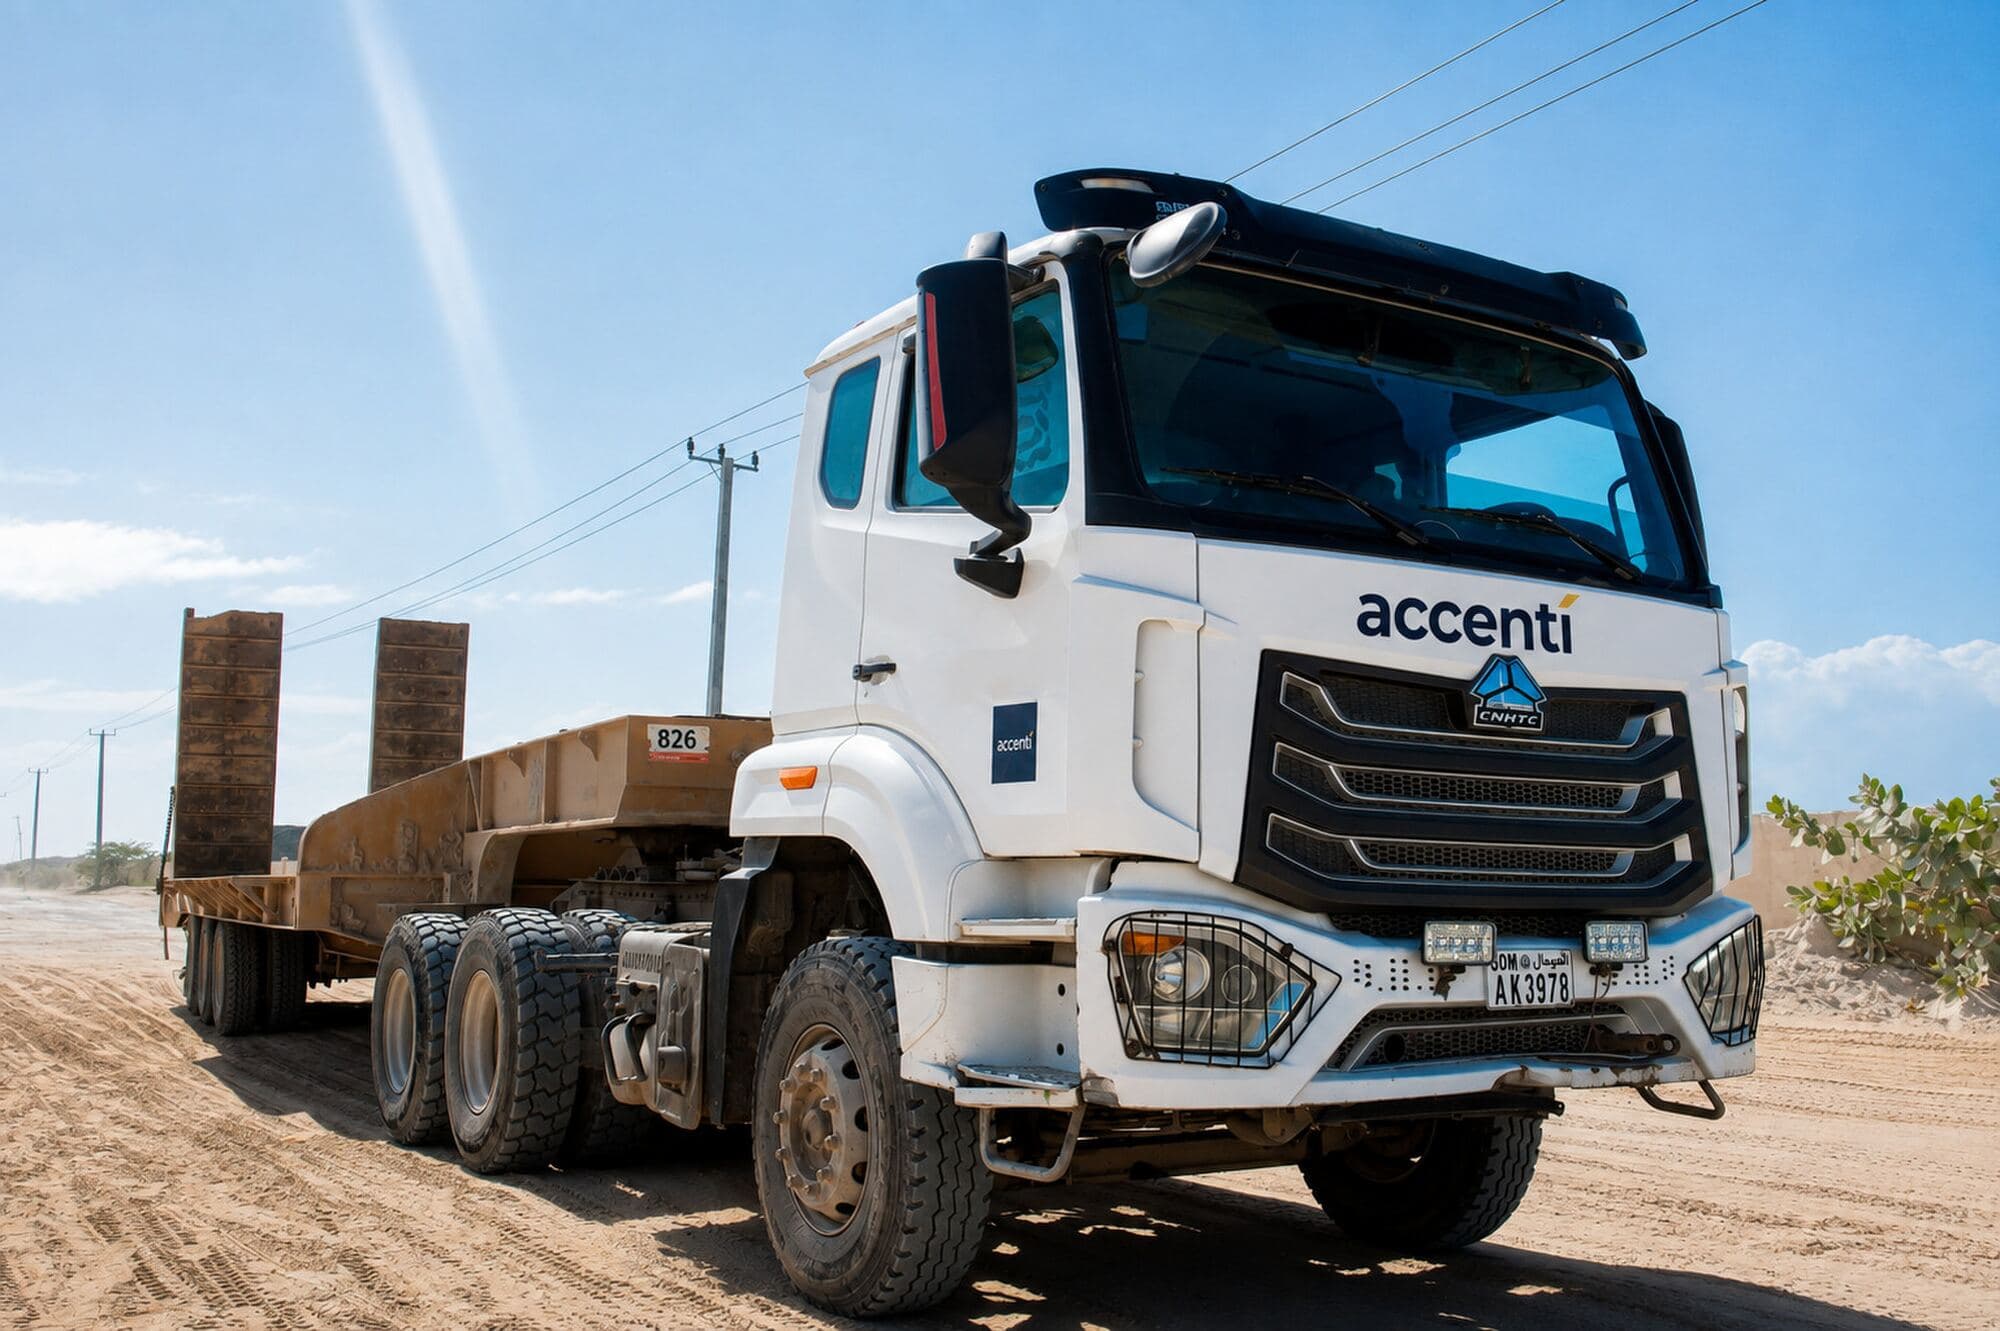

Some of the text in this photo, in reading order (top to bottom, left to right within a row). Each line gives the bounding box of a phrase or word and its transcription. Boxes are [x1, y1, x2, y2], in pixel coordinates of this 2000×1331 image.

[1480, 711, 1538, 725] CNHTC
[658, 729, 697, 749] 826
[1495, 972, 1569, 1005] AK3978
